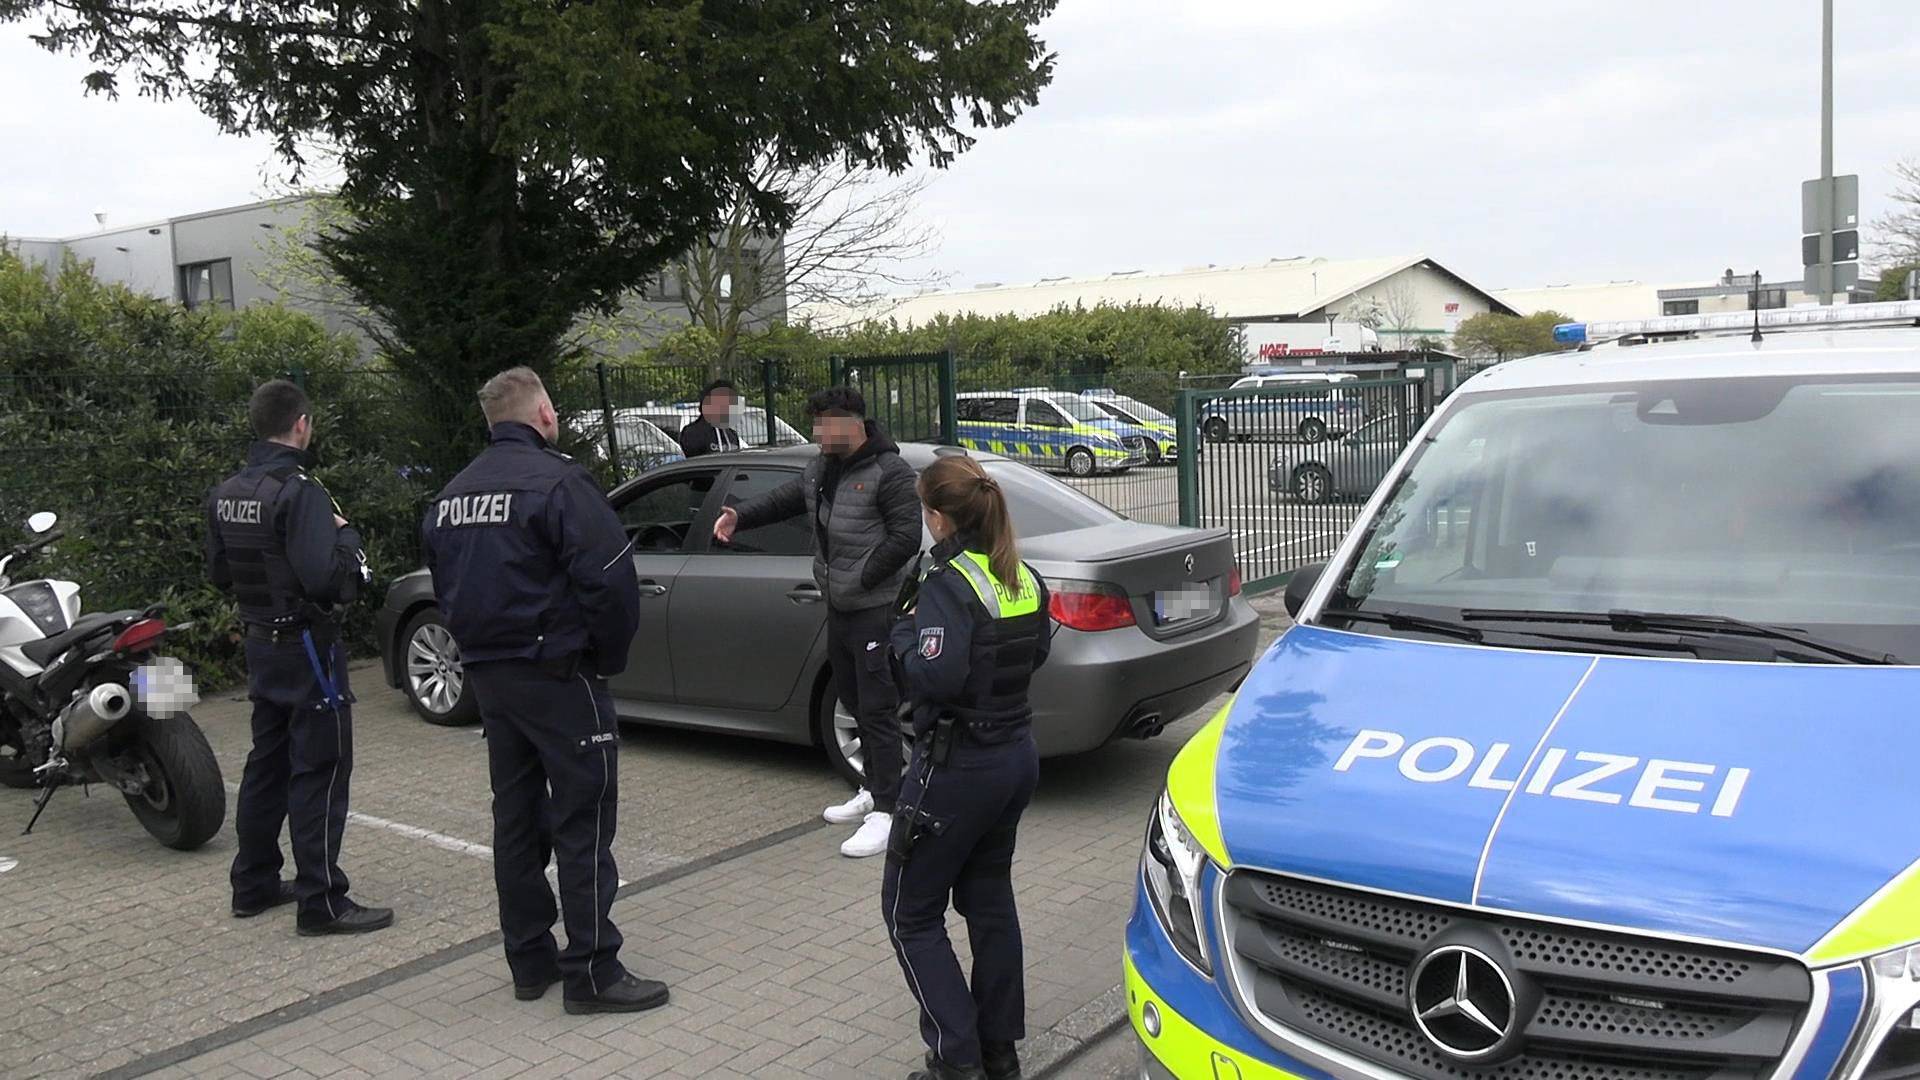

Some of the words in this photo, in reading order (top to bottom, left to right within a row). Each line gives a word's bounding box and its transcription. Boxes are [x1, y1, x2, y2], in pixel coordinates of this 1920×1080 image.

[217, 499, 261, 524] POLIZEI
[436, 494, 512, 527] POLIZEI
[1333, 729, 1750, 817] POLIZEI
